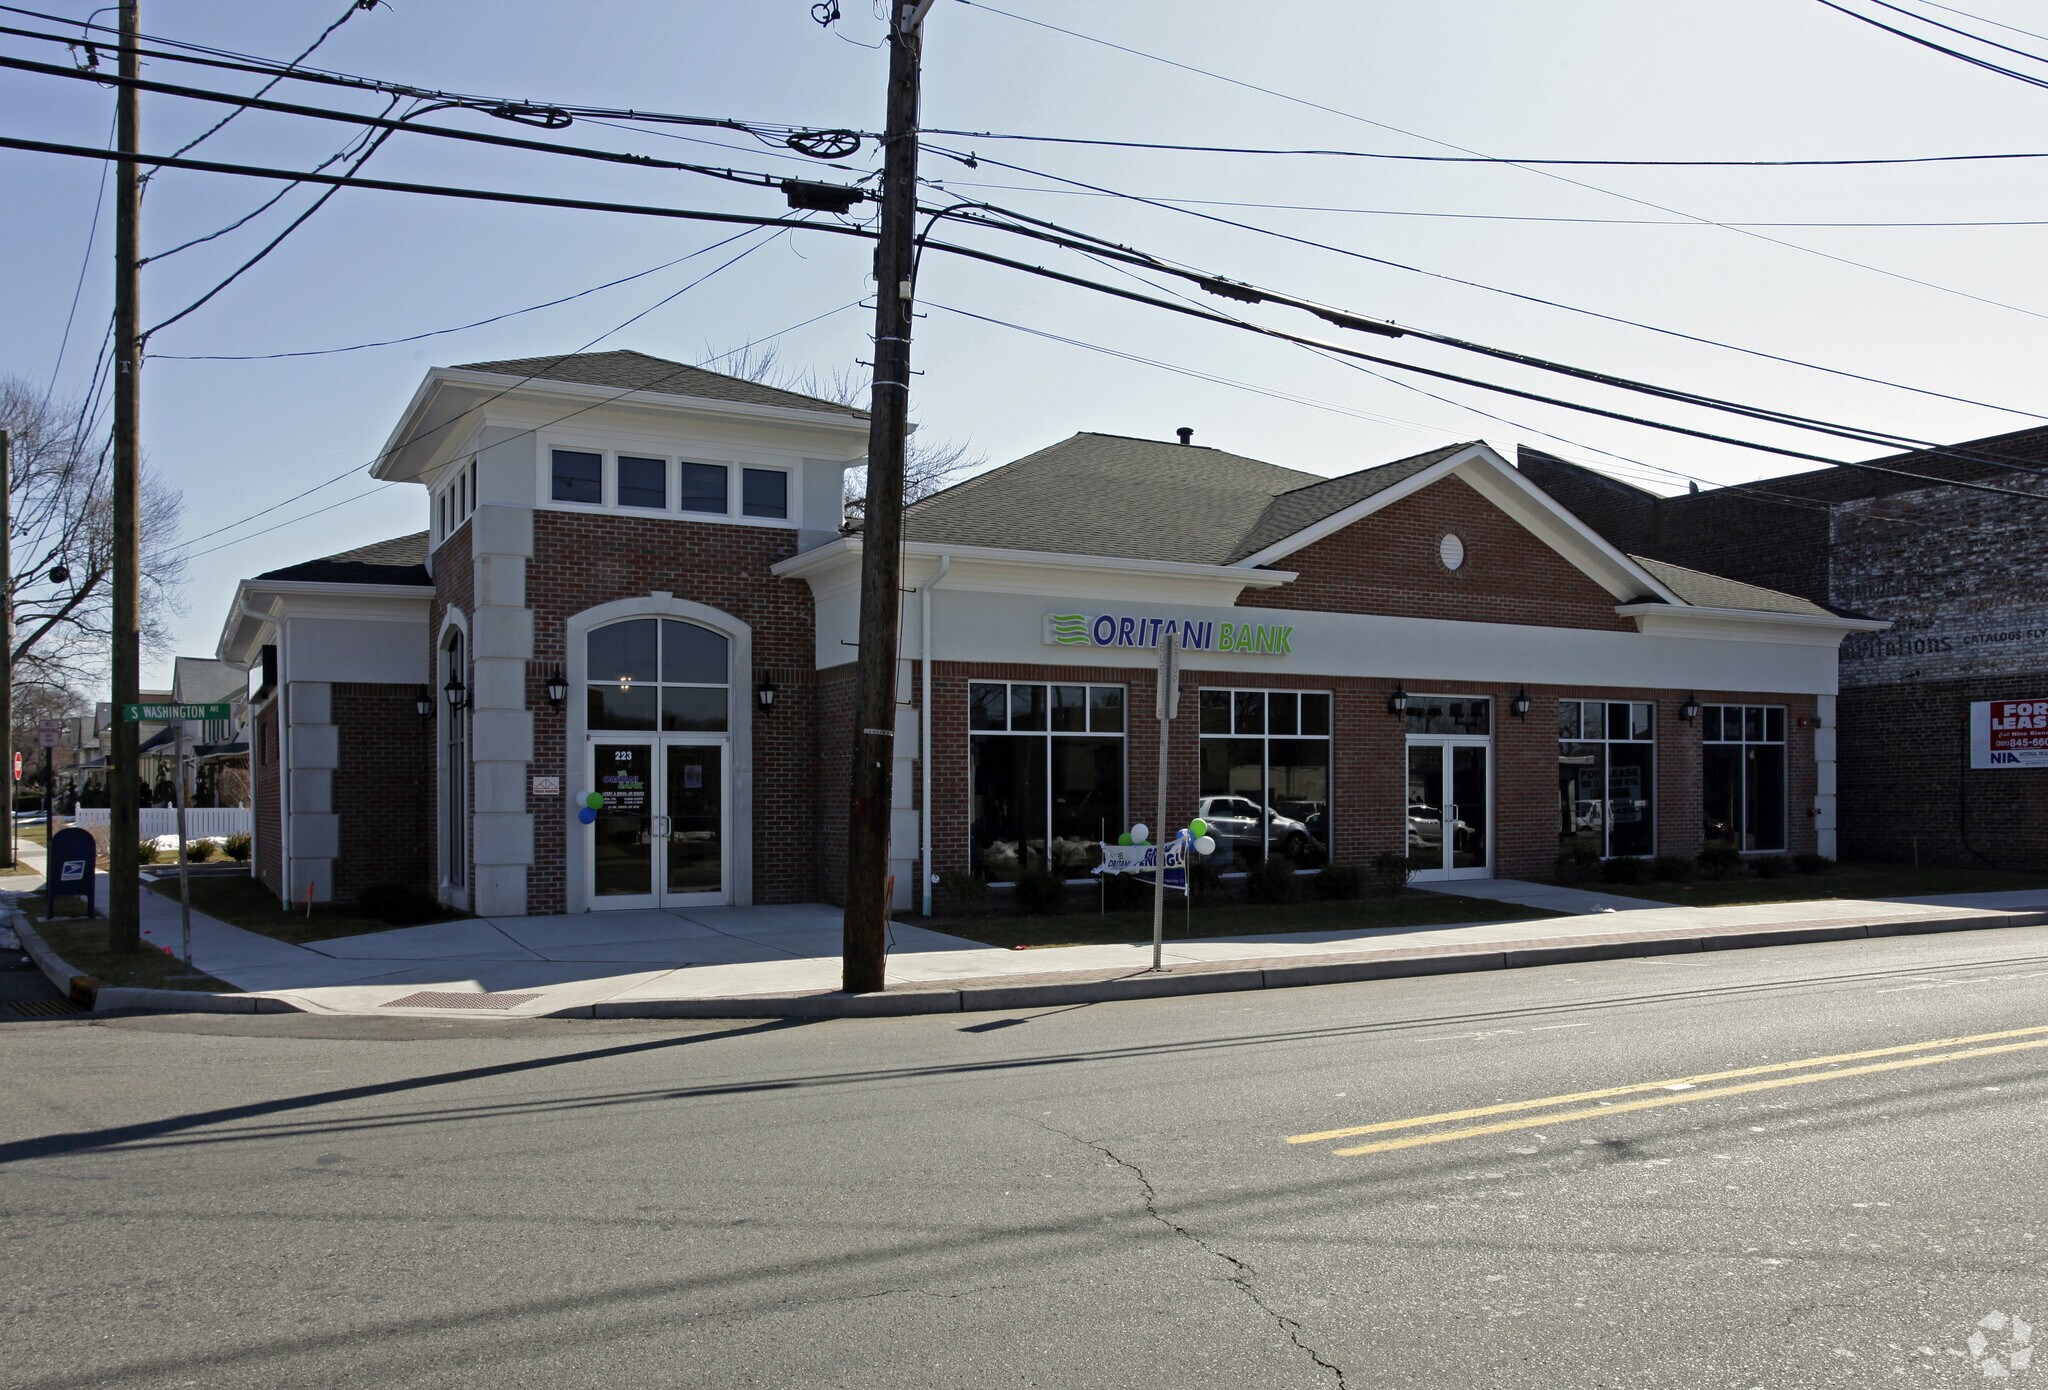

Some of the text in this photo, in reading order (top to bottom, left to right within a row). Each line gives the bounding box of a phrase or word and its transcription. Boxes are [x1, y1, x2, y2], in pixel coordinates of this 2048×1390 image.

[1093, 614, 1294, 654] ORITANI BANK
[131, 707, 139, 719] S
[143, 705, 205, 718] WASHINGTON
[2003, 703, 2048, 716] FOR
[1992, 716, 2048, 730] LEAS
[614, 751, 632, 760] 223
[1990, 752, 2020, 764] NIA
